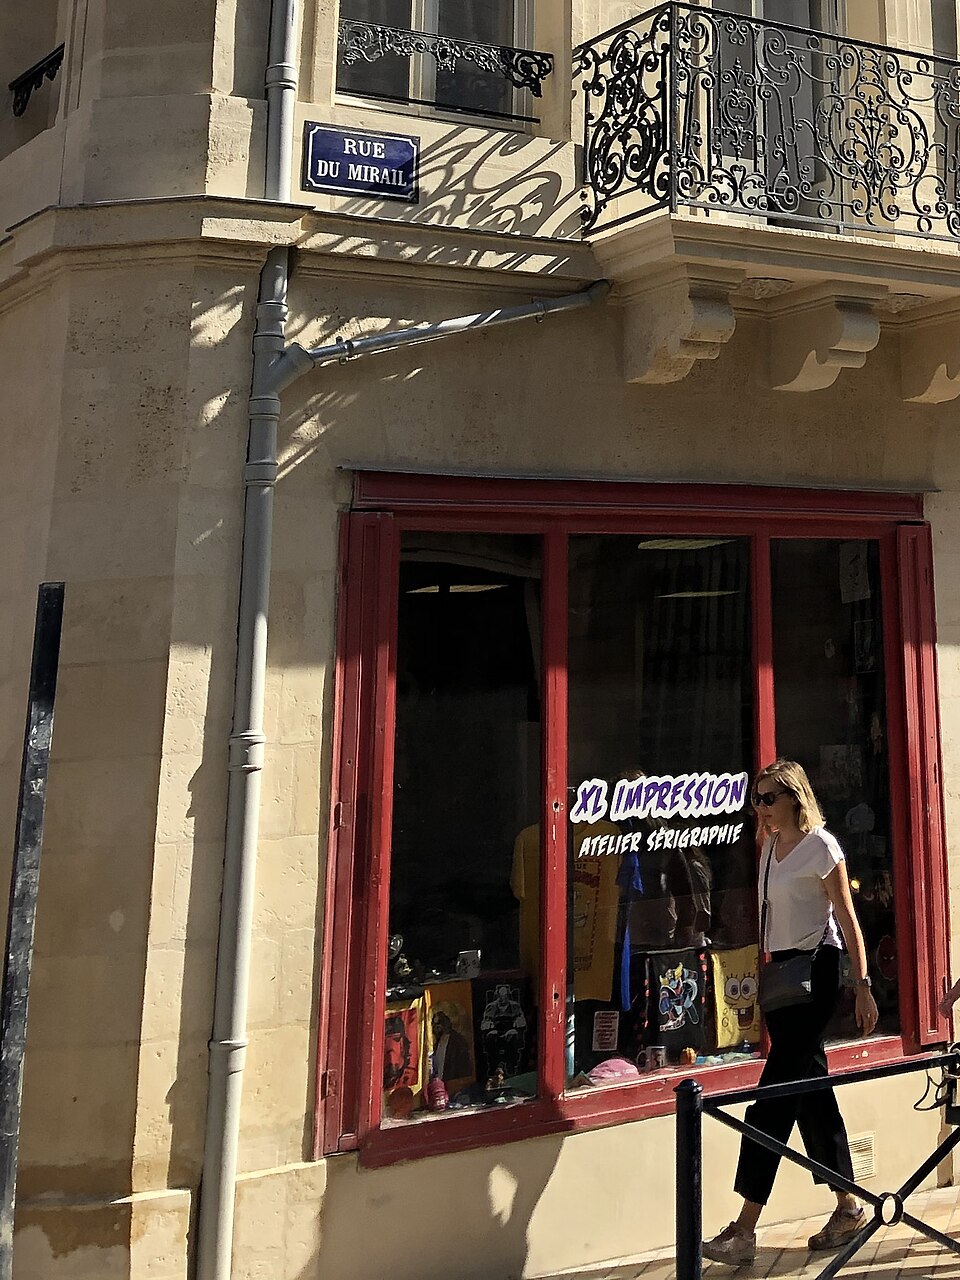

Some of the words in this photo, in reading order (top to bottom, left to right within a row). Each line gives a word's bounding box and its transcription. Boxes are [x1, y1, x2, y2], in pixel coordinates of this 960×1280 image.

[343, 138, 385, 159] RUE
[316, 159, 340, 178] DU
[347, 163, 407, 187] MIRAIL
[573, 782, 605, 819] XL
[613, 775, 747, 816] IMPRESSION
[578, 832, 642, 858] ATELIER
[647, 823, 744, 852] SÉRIGRAPHIE
